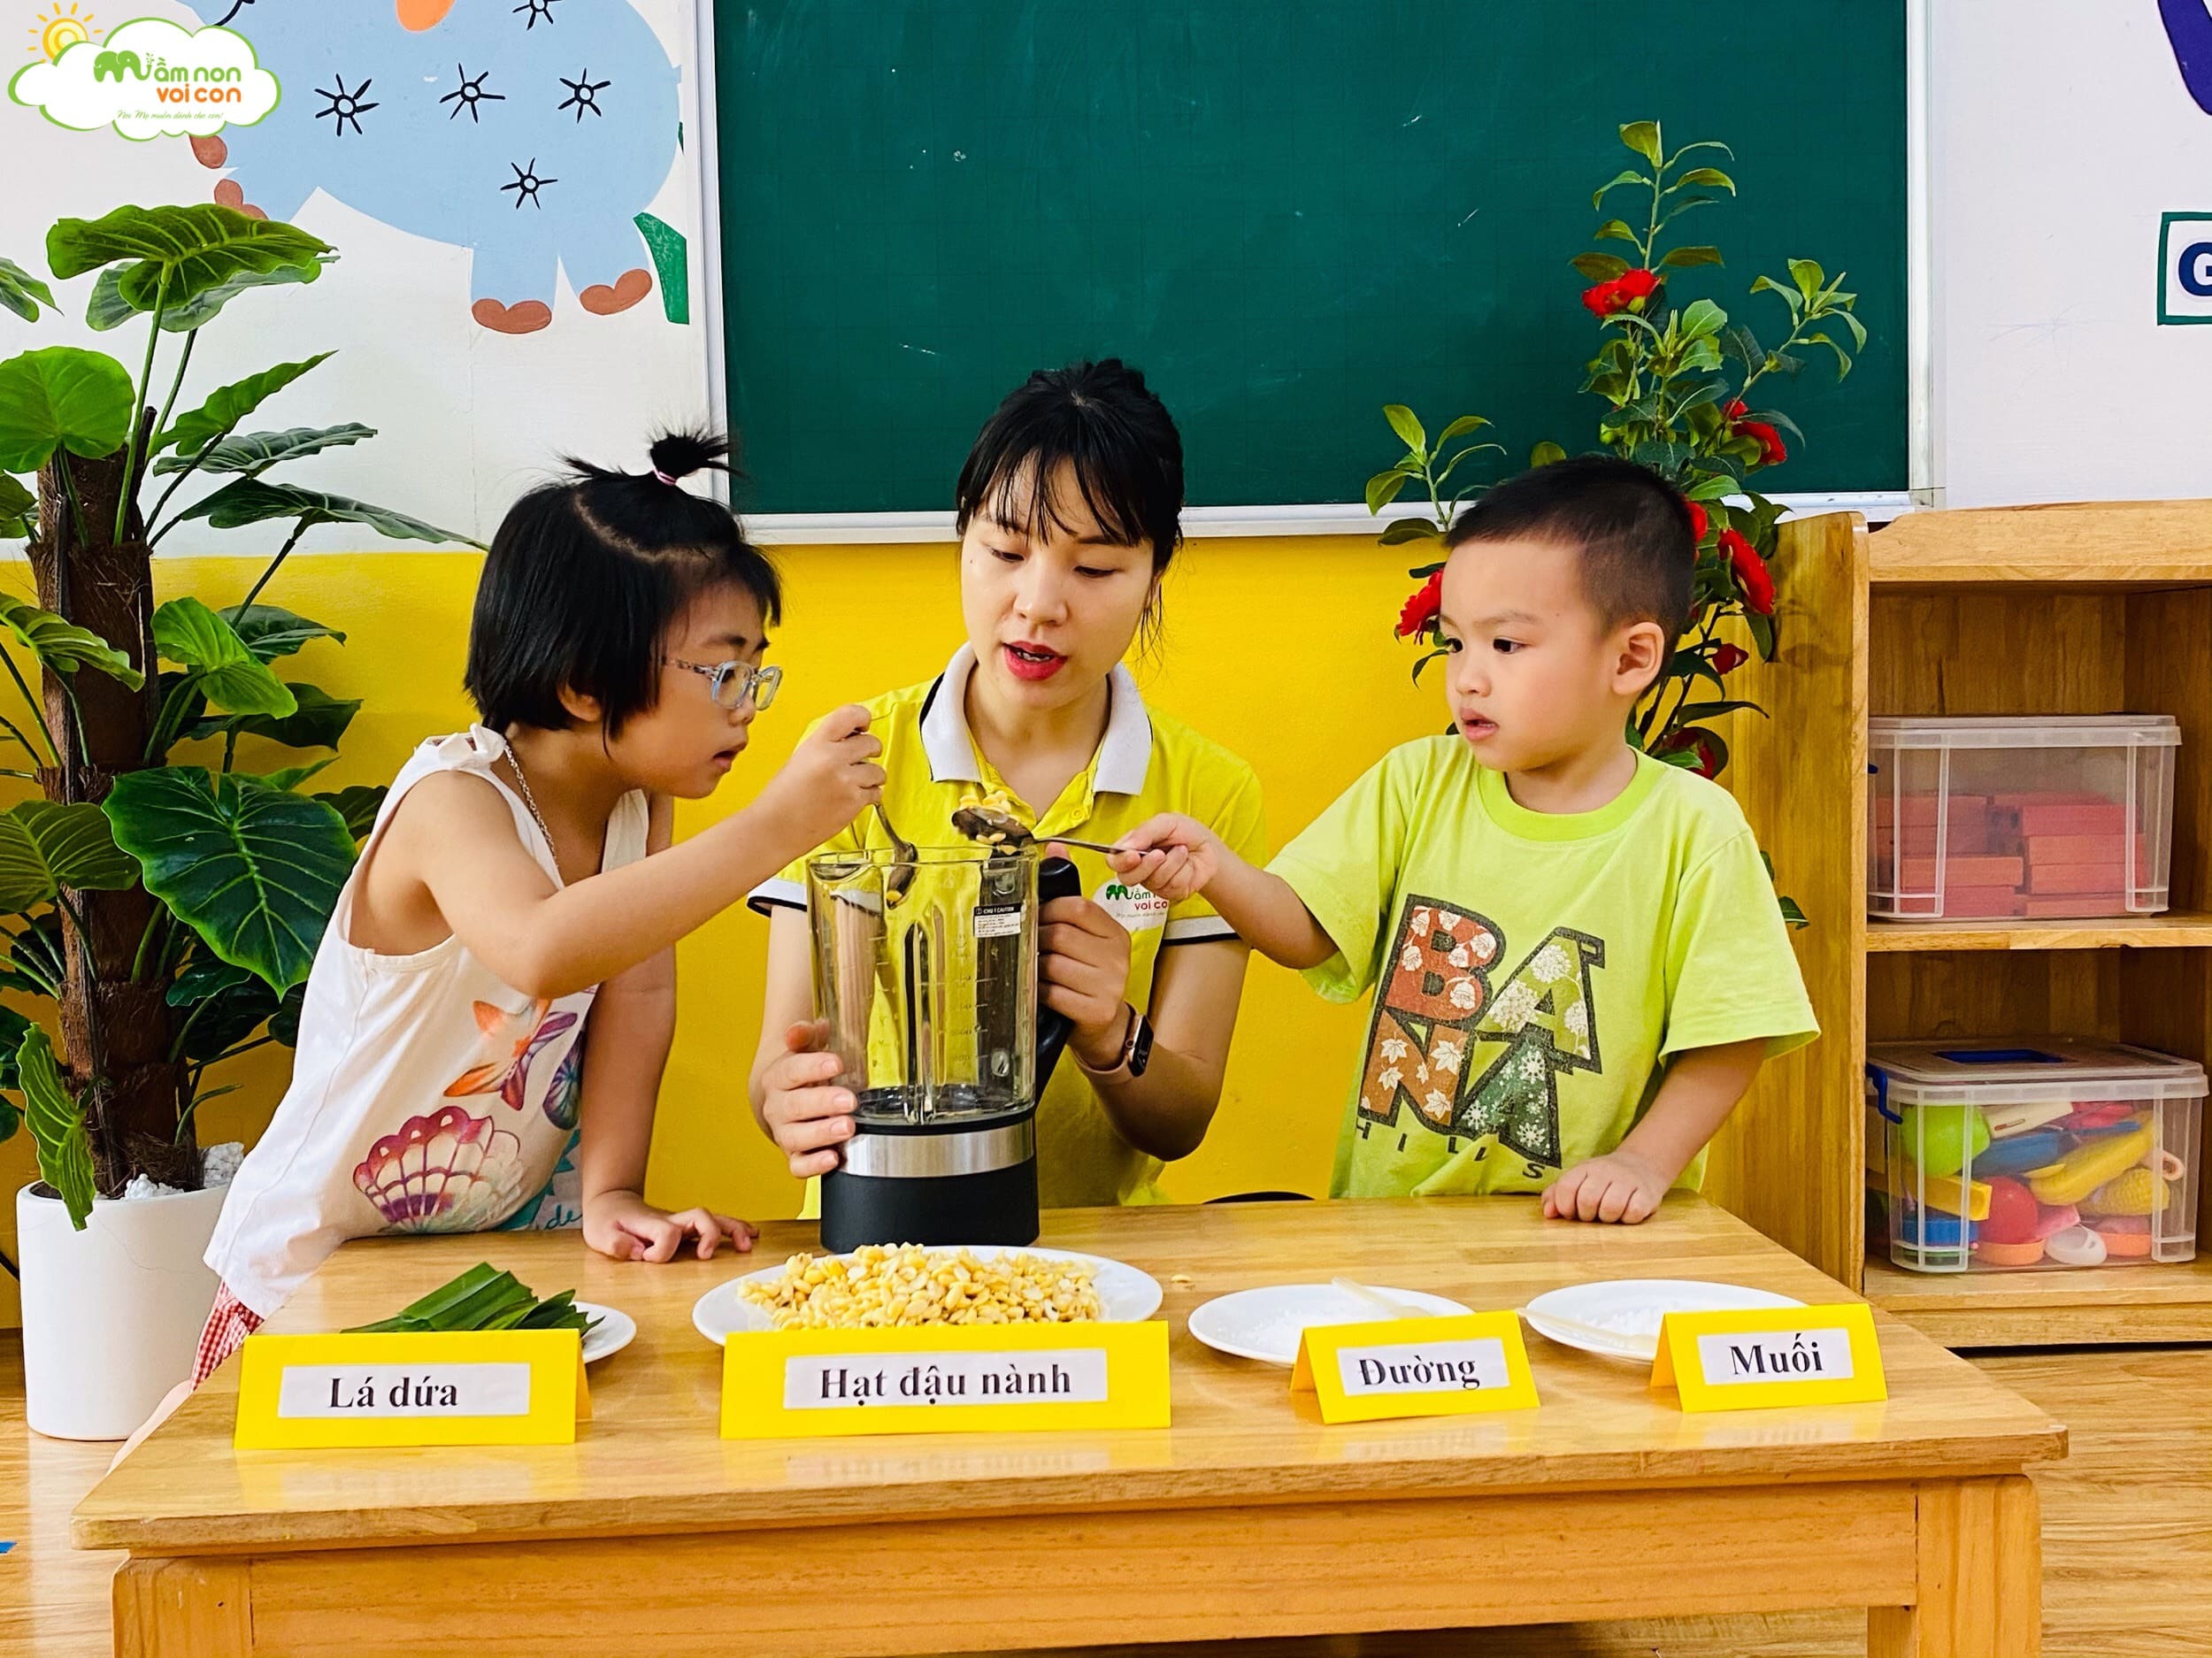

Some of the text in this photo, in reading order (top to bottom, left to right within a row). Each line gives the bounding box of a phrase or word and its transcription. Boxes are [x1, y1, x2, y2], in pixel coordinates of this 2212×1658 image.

[1154, 901, 1168, 910] co
[1729, 1332, 1824, 1376] Muối
[819, 1363, 1071, 1407] Hạt đậu nành
[1358, 1355, 1481, 1391] Đường
[328, 1375, 458, 1409] Lá dứa
